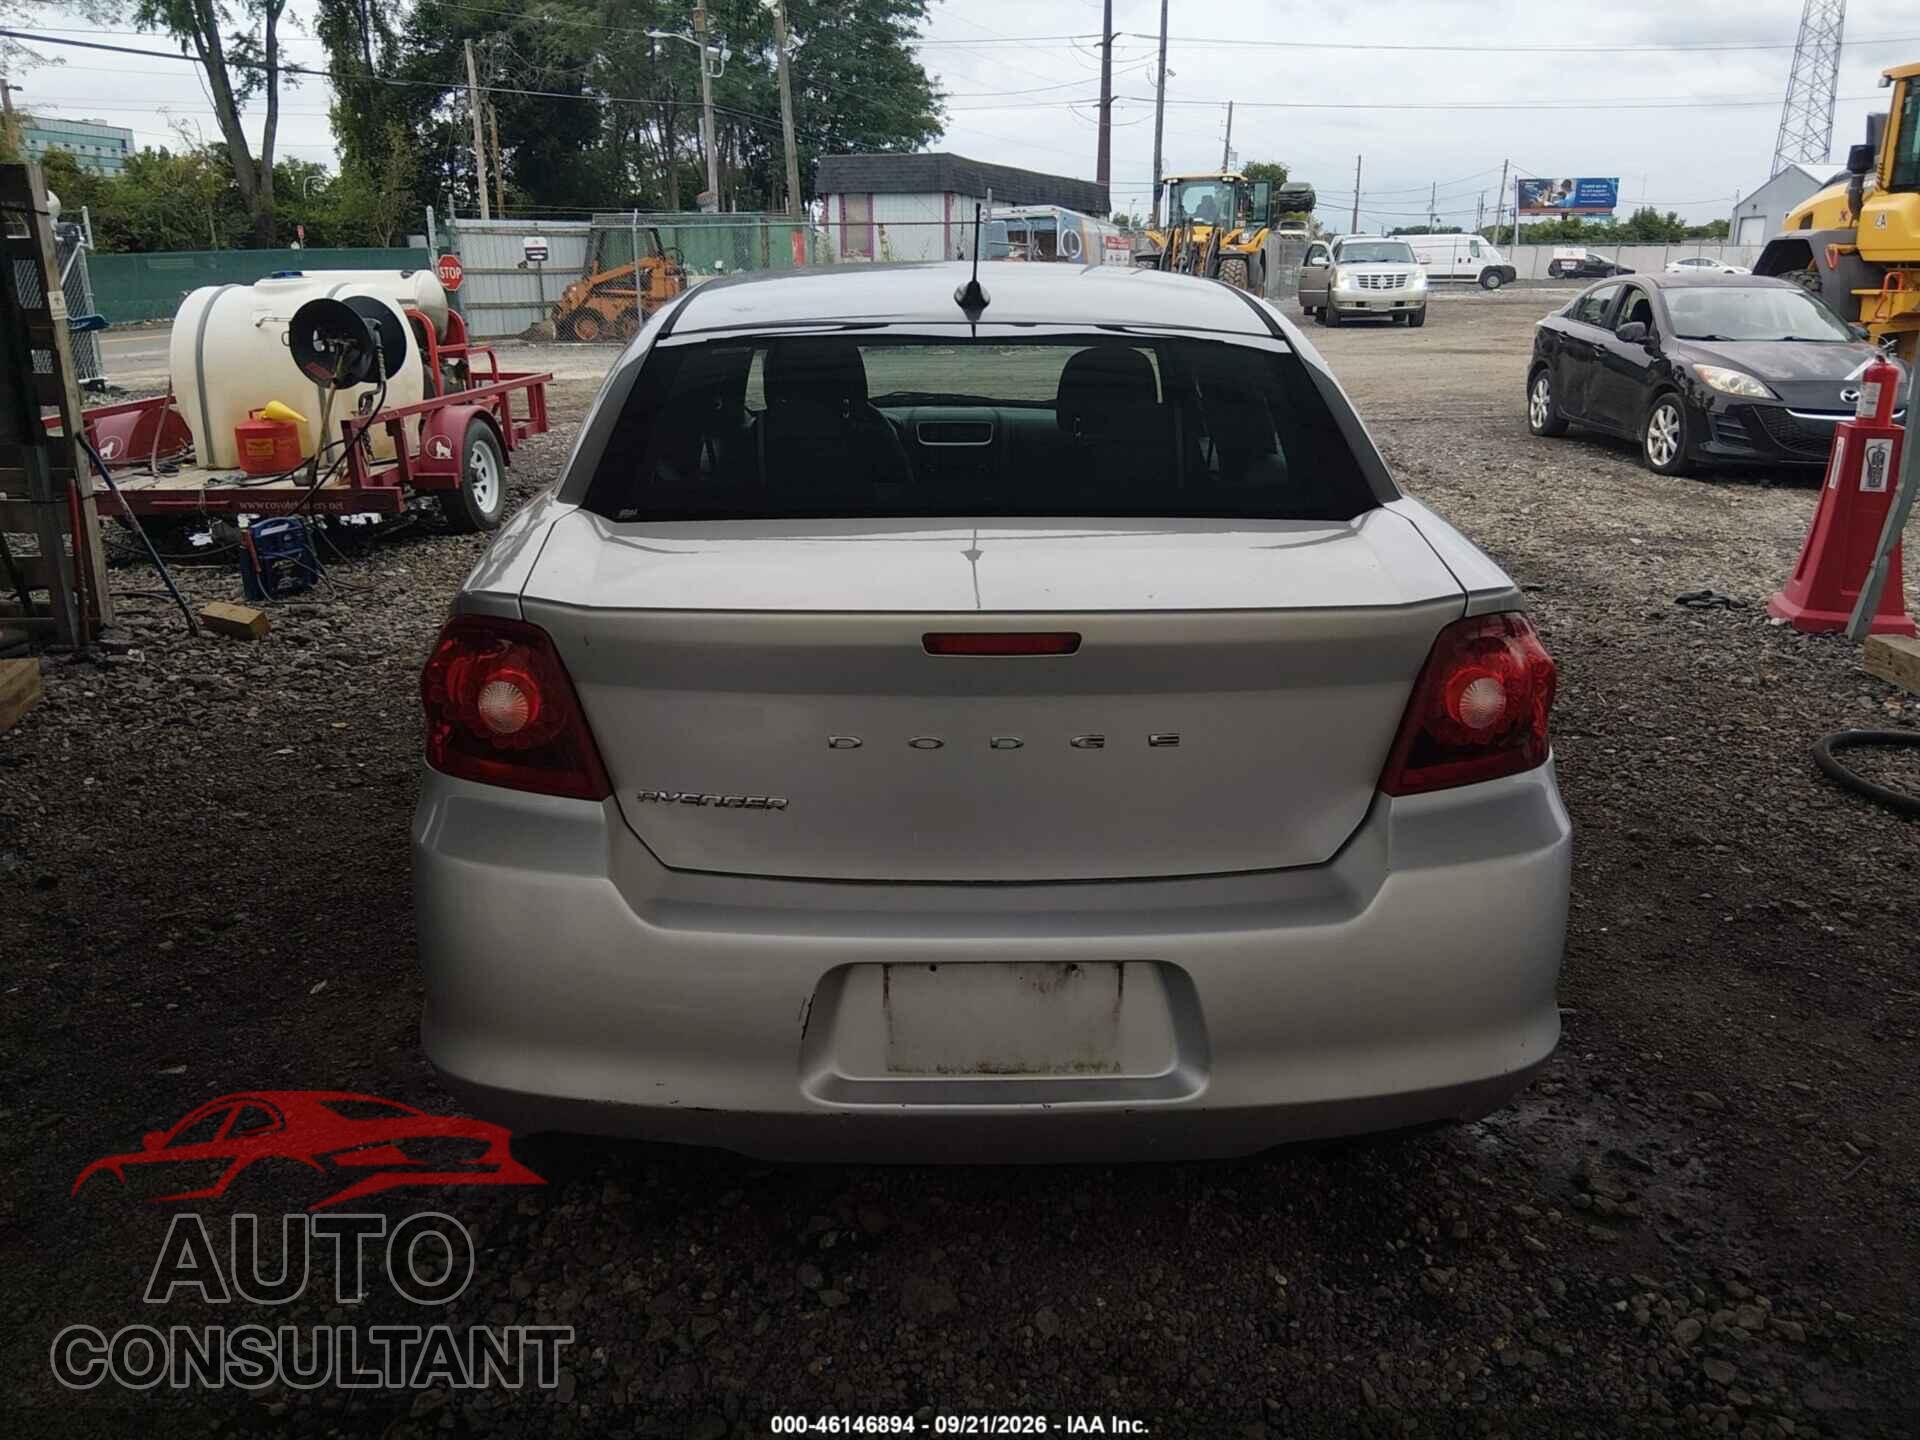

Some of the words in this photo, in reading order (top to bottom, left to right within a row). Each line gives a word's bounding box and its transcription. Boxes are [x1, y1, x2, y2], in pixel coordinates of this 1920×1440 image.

[440, 266, 462, 280] STOP
[828, 733, 1180, 750] DODGE
[638, 790, 789, 811] AVENGER
